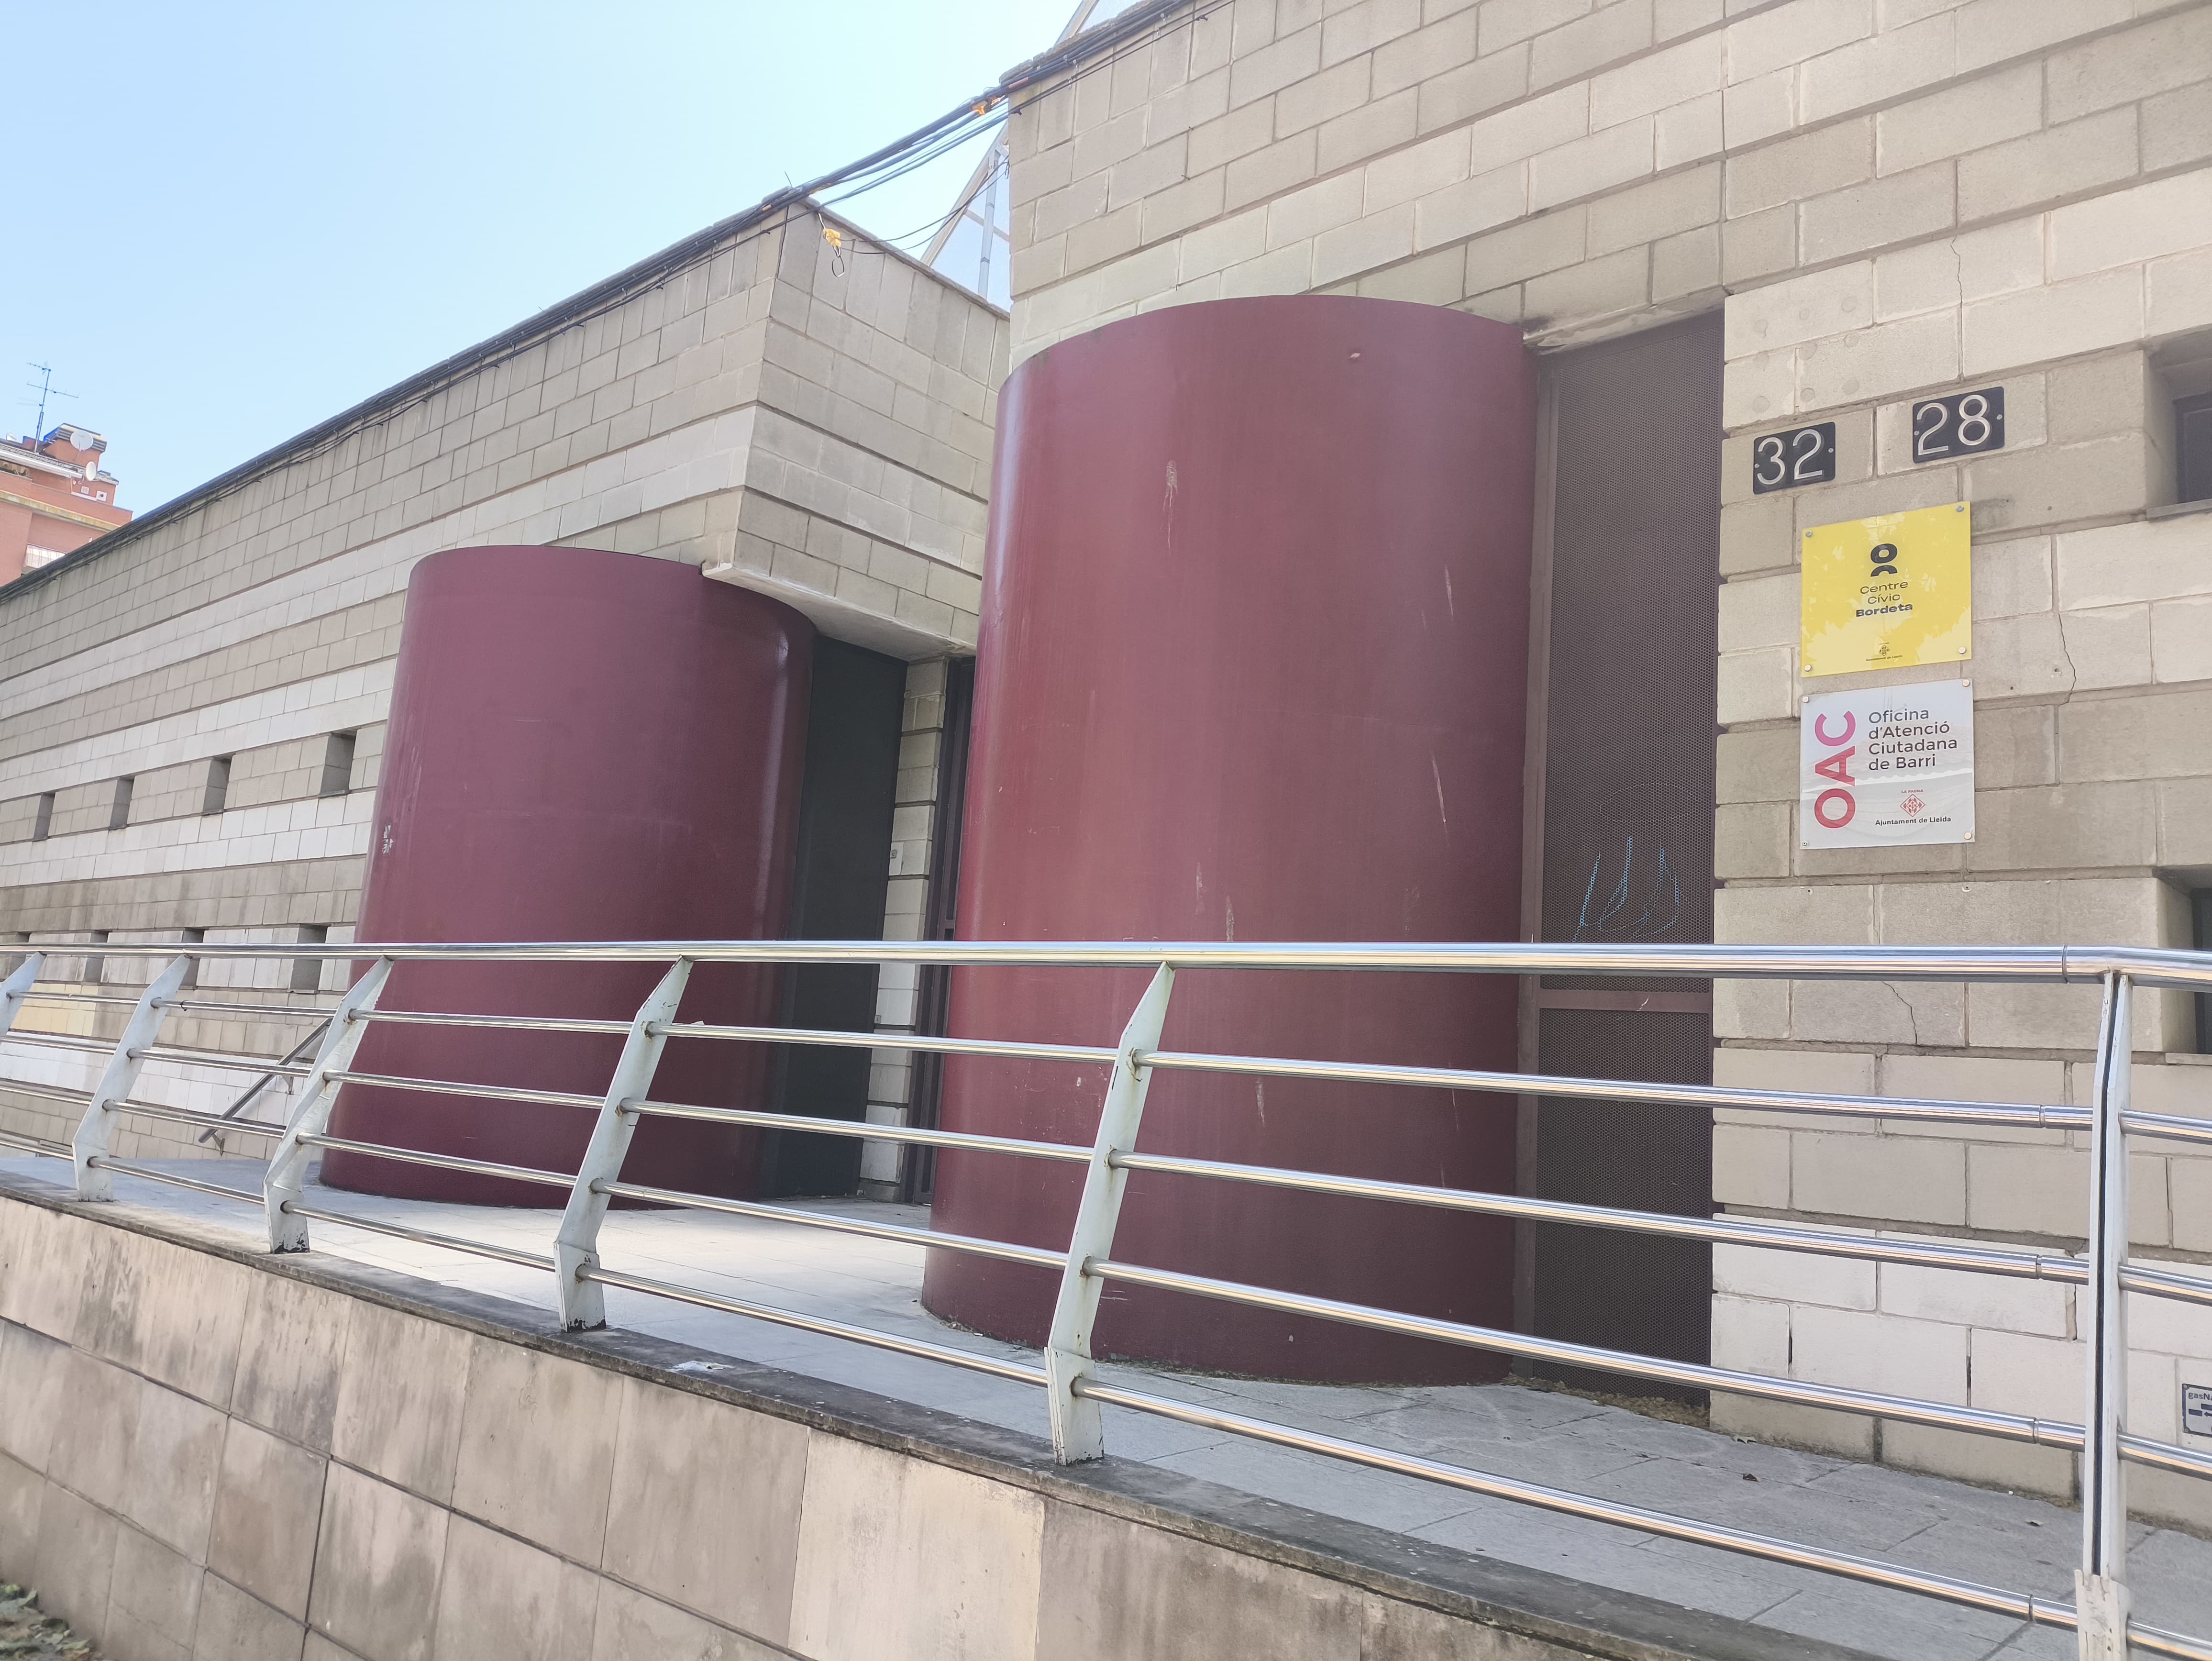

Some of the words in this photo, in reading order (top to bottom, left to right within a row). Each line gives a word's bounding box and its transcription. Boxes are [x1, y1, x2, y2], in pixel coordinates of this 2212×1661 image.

[1916, 394, 1991, 456] 28
[1757, 429, 1823, 485] 32
[1860, 581, 1909, 594] Centre
[1868, 594, 1901, 604] Cívic
[1856, 604, 1913, 617] Bordeta
[1869, 708, 1929, 724] Oficina
[1869, 721, 1950, 740] d'Atenció
[1869, 739, 1958, 755] Ciutadana
[1814, 710, 1856, 829] OAC
[1869, 758, 1890, 771] de
[1896, 754, 1936, 769] Barri
[2188, 1392, 2212, 1401] gasN
